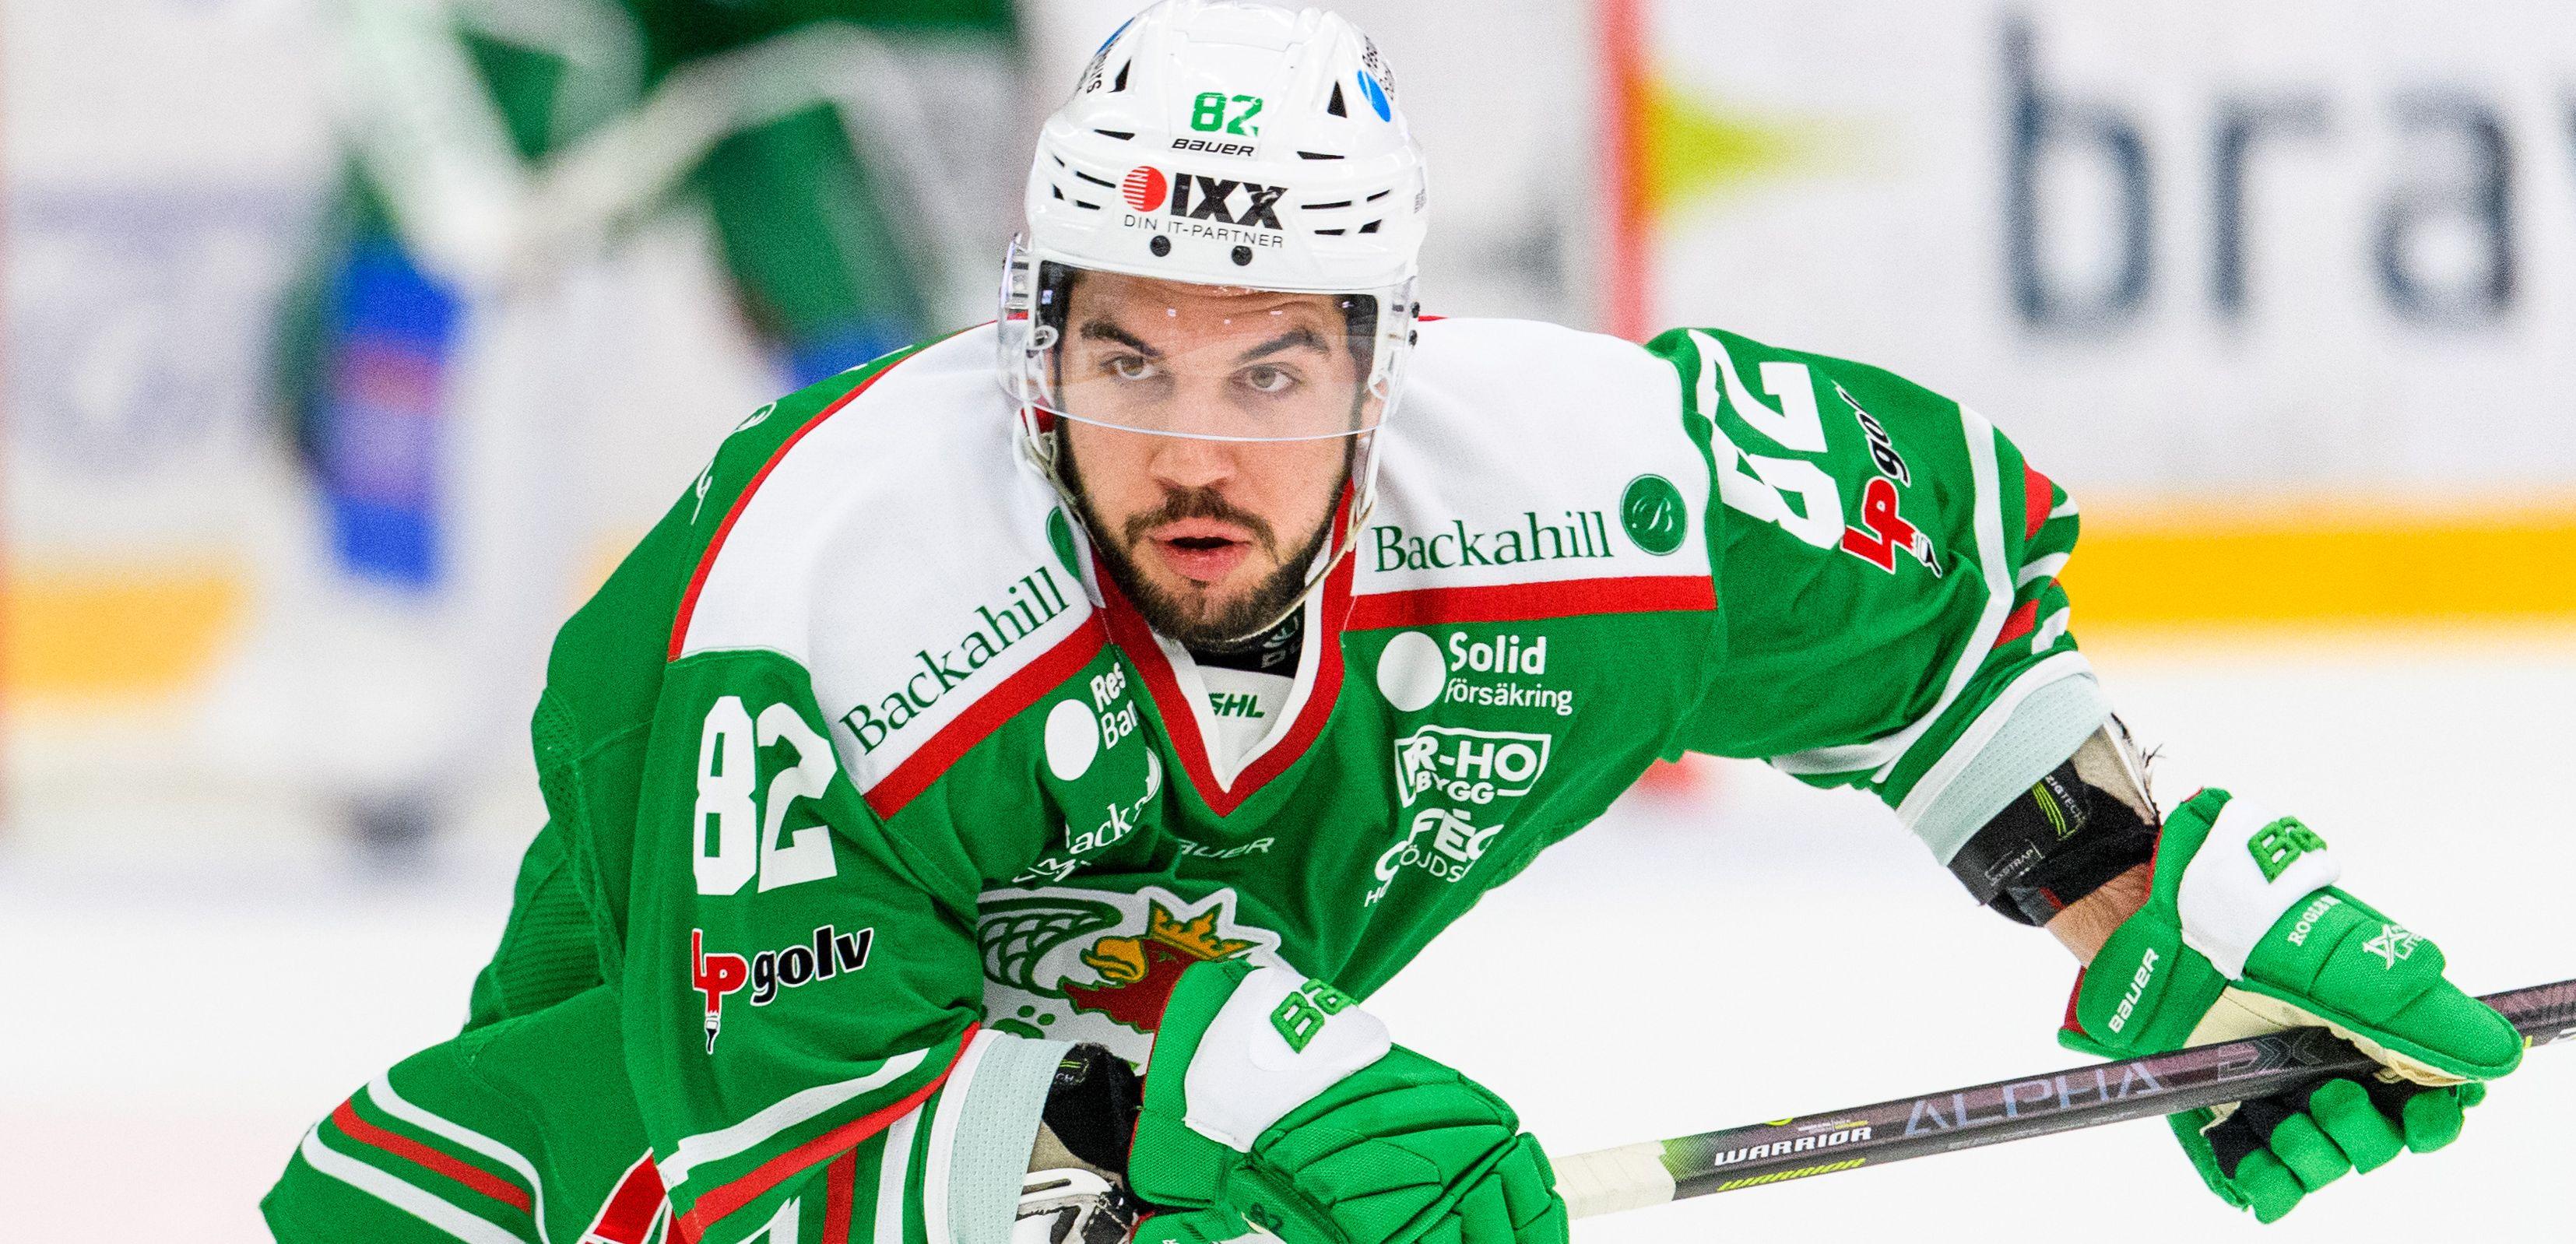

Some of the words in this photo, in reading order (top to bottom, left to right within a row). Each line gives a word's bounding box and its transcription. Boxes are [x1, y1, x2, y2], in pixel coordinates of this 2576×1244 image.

[1190, 92, 1263, 137] 82
[1171, 173, 1289, 230] IXX
[1994, 12, 2576, 336] bra
[1123, 214, 1158, 230] DIN
[1168, 221, 1284, 248] IT-PARTNER
[1688, 329, 1846, 551] 82
[1372, 511, 1615, 573] Backahill
[839, 567, 1070, 755] Backahill
[1449, 631, 1547, 675] Solid
[1208, 692, 1266, 719] SHL
[1444, 678, 1573, 715] försäkring
[693, 695, 838, 895] 82
[1415, 771, 1495, 804] BYGG
[750, 924, 873, 1006] golv
[1714, 1126, 1871, 1167] WARRIOR
[1904, 1061, 2163, 1138] ALPHA
